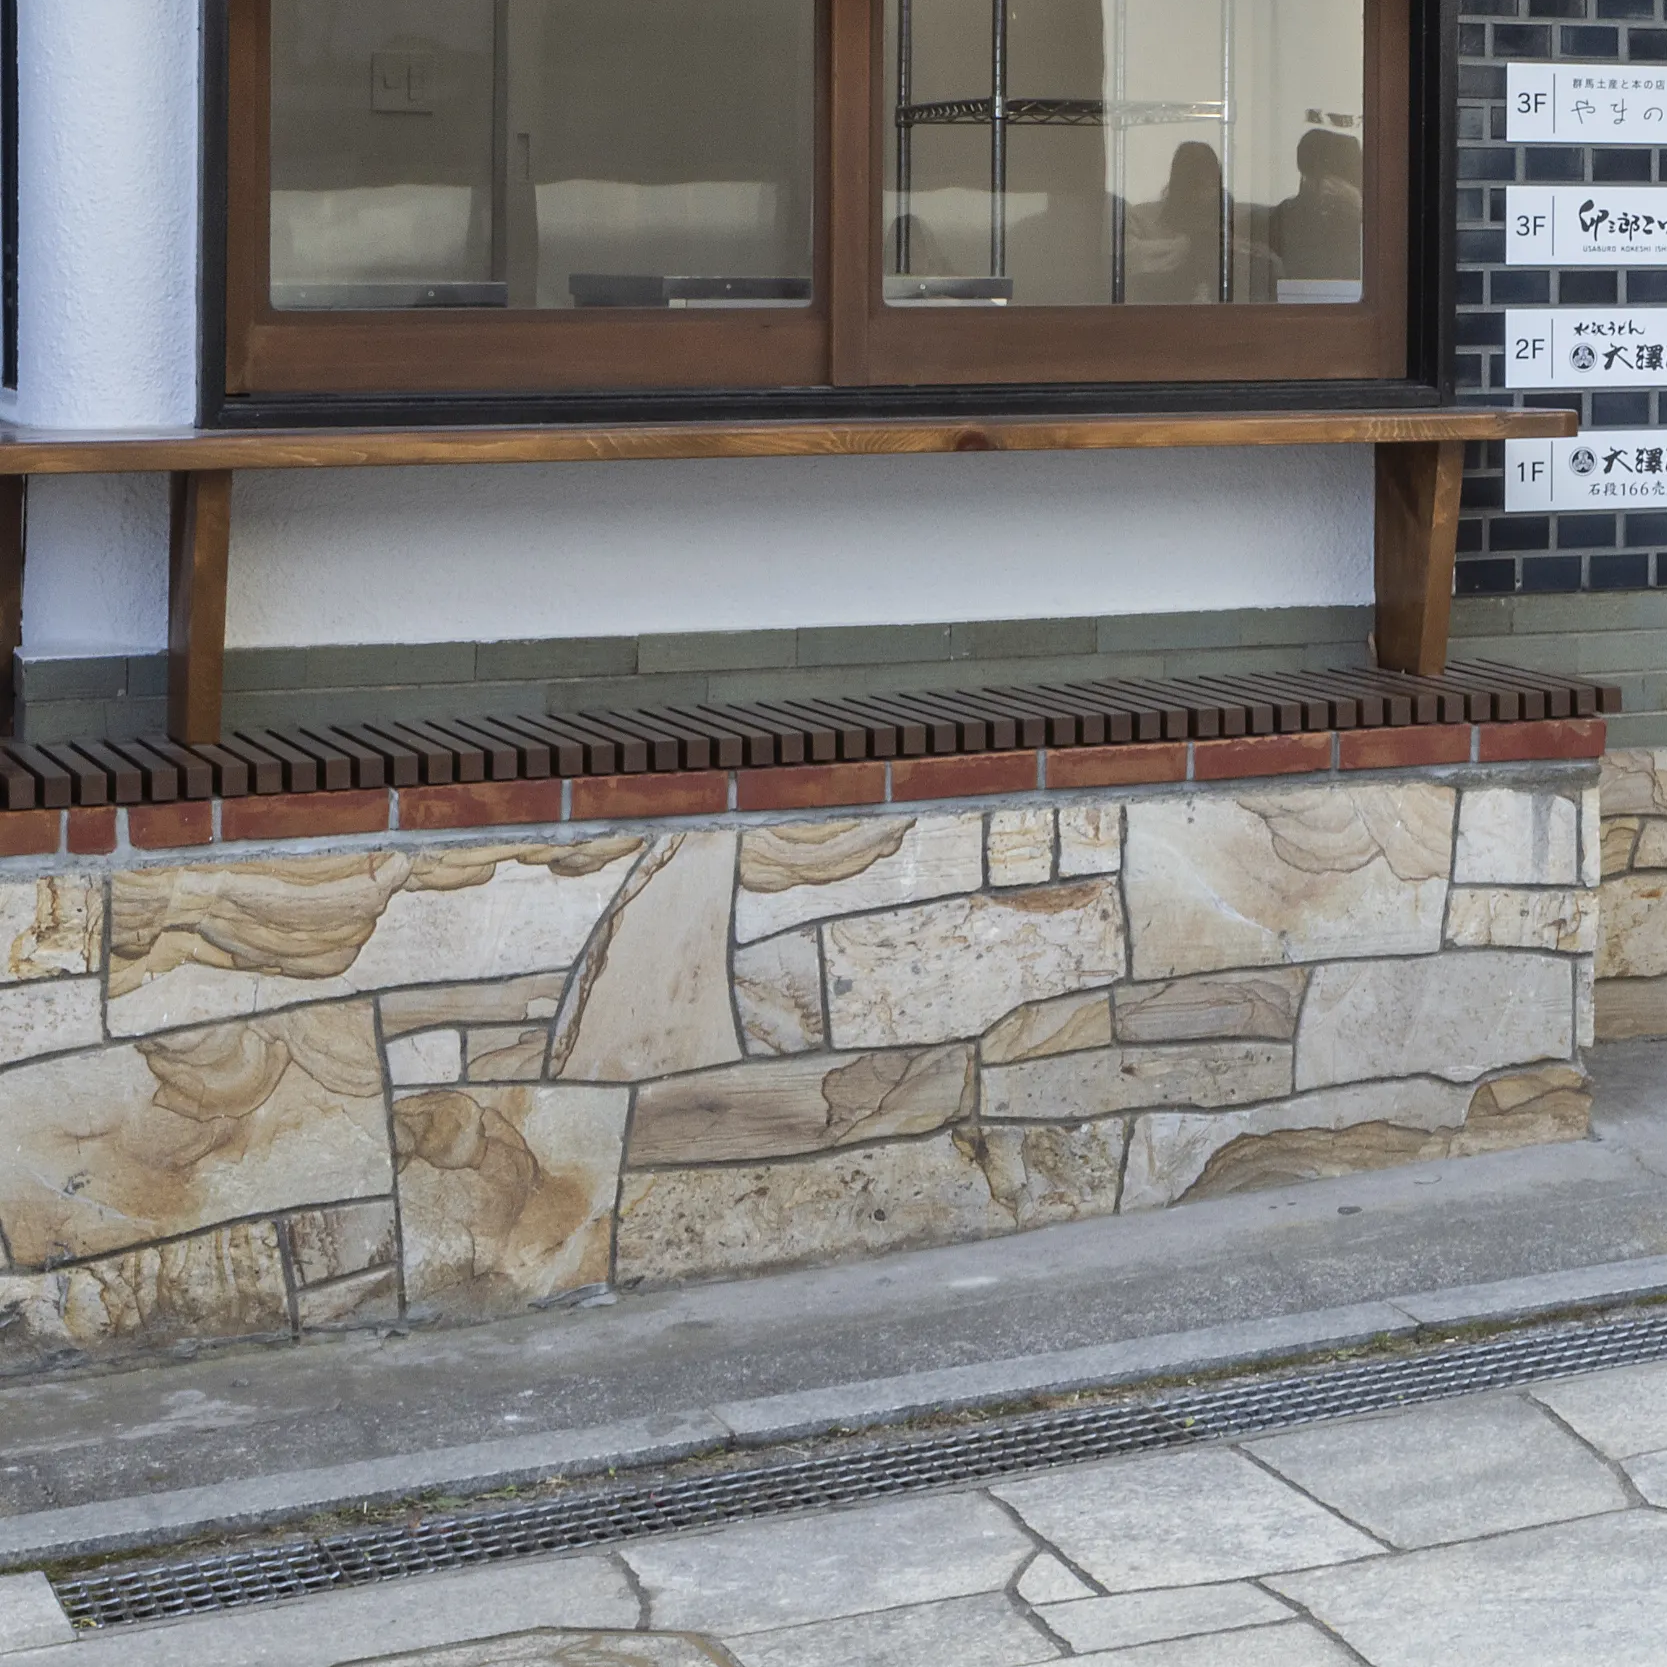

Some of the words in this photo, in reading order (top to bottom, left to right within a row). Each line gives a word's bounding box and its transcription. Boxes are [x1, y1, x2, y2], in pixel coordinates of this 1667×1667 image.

[1573, 78, 1664, 90] 群馬土産と本の店
[1518, 93, 1546, 113] 3F
[1516, 216, 1545, 236] 3F
[1582, 245, 1617, 253] USABURO
[1620, 245, 1652, 253] KOKESHI
[1516, 339, 1544, 359] 2F
[1518, 462, 1544, 482] 1F
